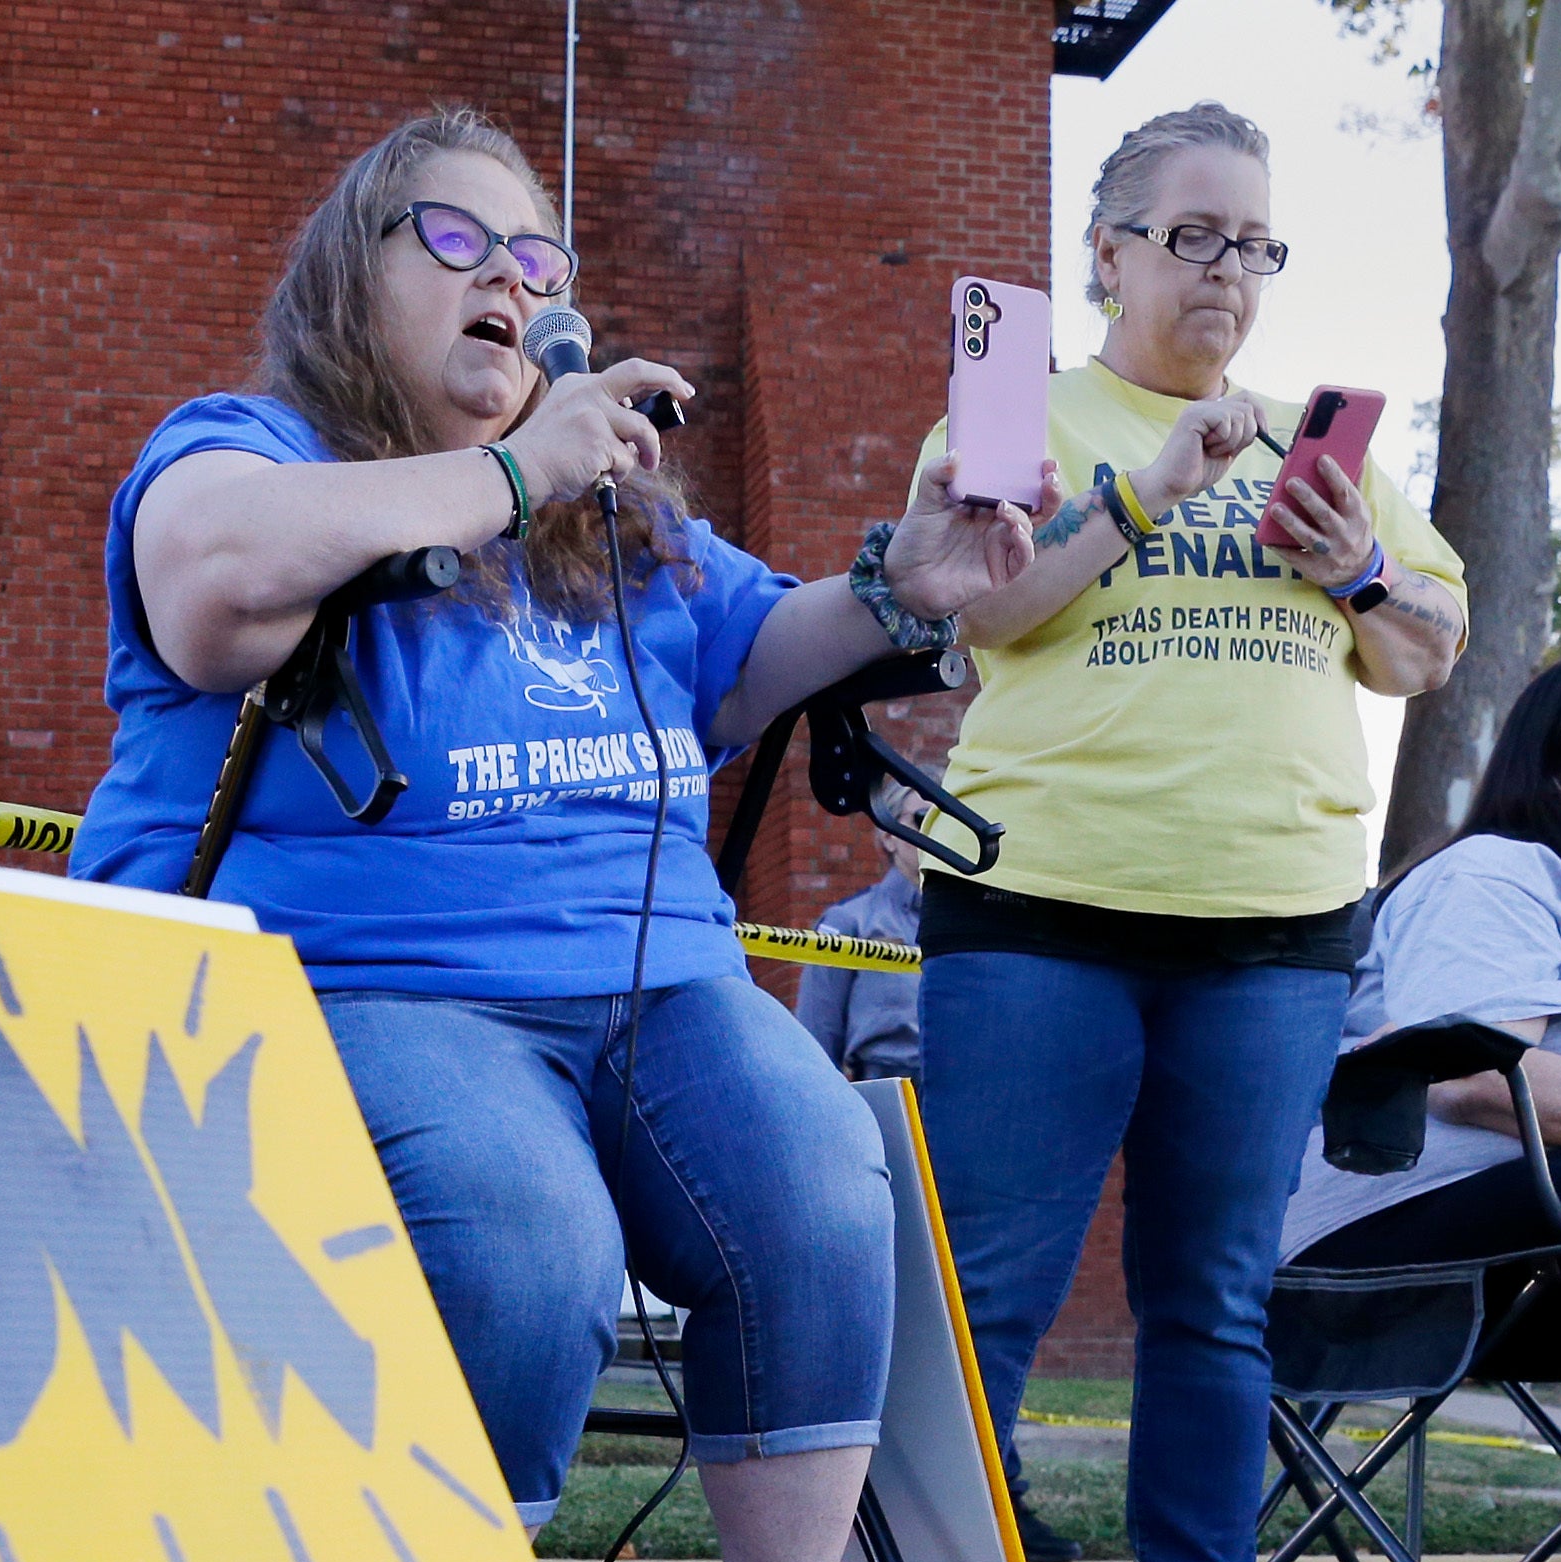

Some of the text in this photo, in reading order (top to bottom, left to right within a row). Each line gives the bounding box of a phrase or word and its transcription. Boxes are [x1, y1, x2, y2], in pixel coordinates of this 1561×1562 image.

[1091, 606, 1340, 650] TEXAS DEATH PENALTY
[1086, 636, 1220, 668] ABOLITION
[448, 743, 520, 793] THE
[525, 732, 636, 785] PRISON
[509, 790, 551, 812] FM
